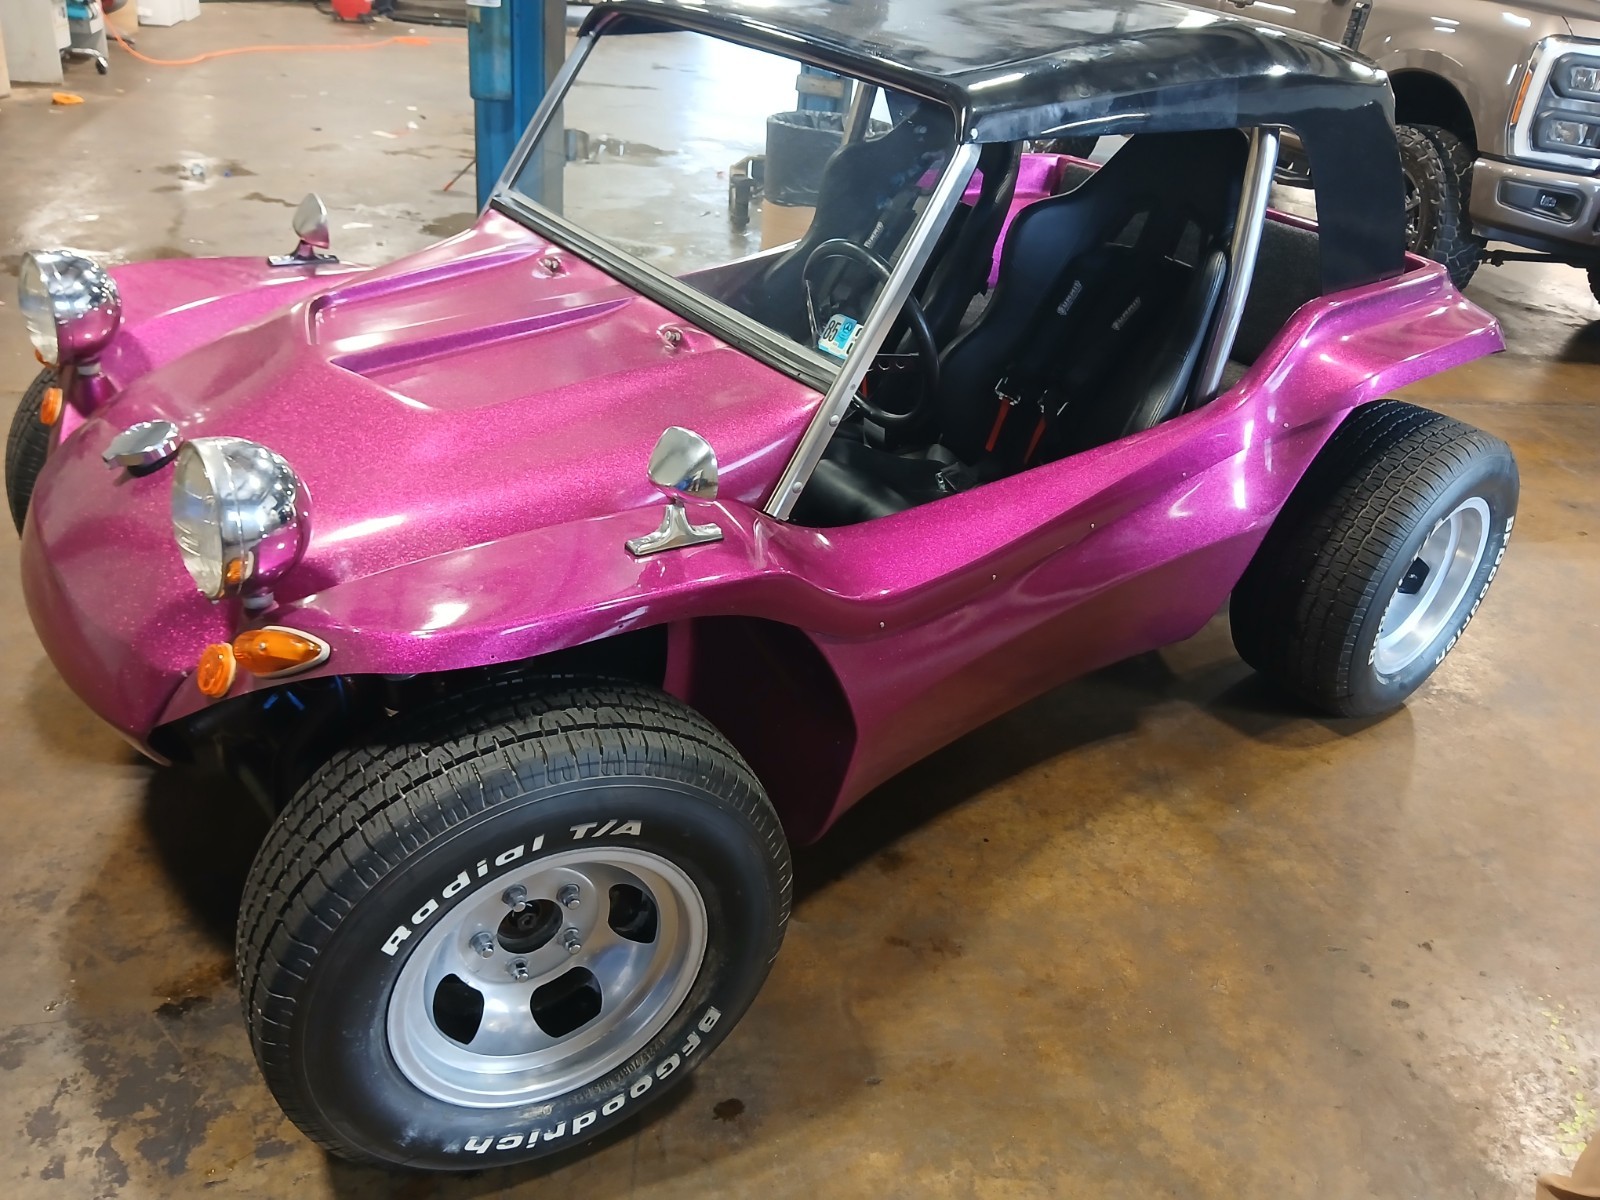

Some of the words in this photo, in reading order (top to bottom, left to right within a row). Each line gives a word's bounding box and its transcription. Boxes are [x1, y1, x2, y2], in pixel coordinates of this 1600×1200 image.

[380, 834, 545, 956] Radial
[569, 819, 642, 840] T/A
[464, 1006, 722, 1154] BFGoodrich
